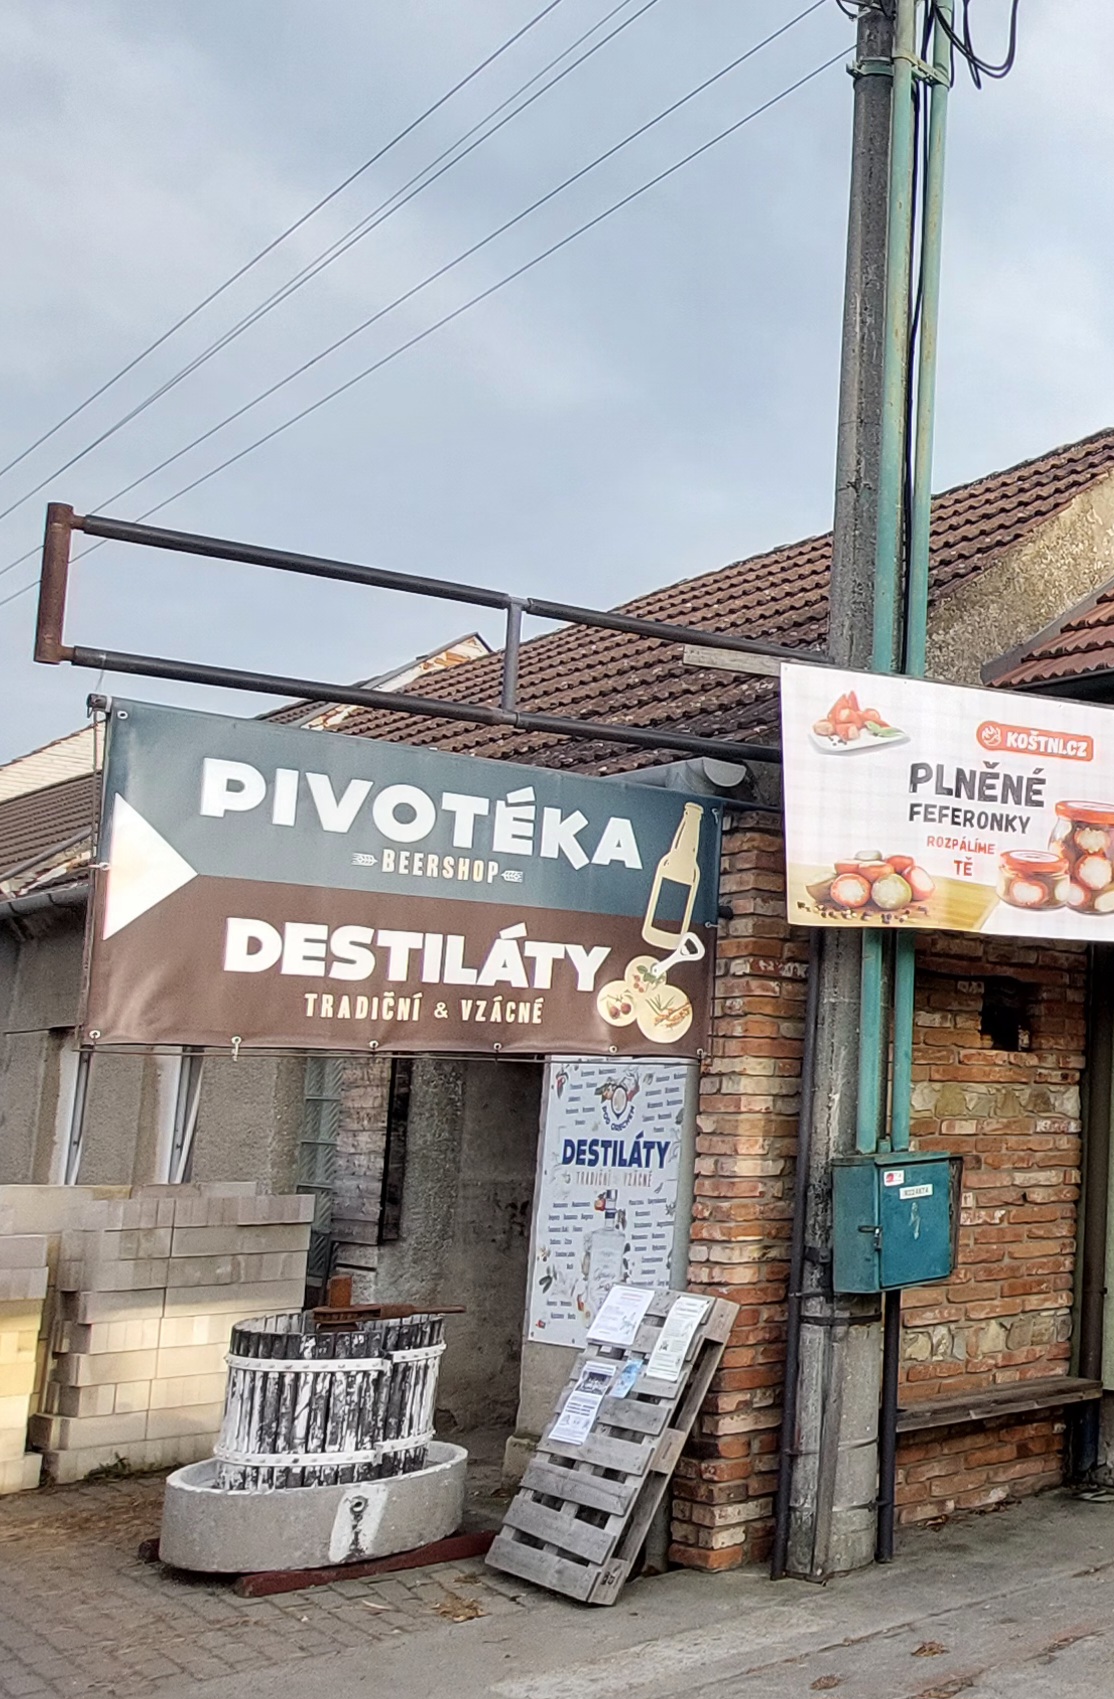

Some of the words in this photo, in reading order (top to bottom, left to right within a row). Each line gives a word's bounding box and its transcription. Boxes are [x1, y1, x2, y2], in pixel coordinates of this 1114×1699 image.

[909, 761, 1047, 808] PLNĚNÉ
[200, 756, 644, 871] PIVOTÉKA
[909, 803, 1031, 834] FEFERONKY
[381, 848, 500, 884] BEERSHOP
[953, 856, 974, 877] TĚ
[223, 916, 611, 992] DESTILÁTY
[304, 990, 423, 1022] TRADIČNÍ
[434, 1001, 448, 1018] &
[461, 995, 545, 1025] VZÁCNÉ
[562, 1130, 671, 1169] DESTILÁTY
